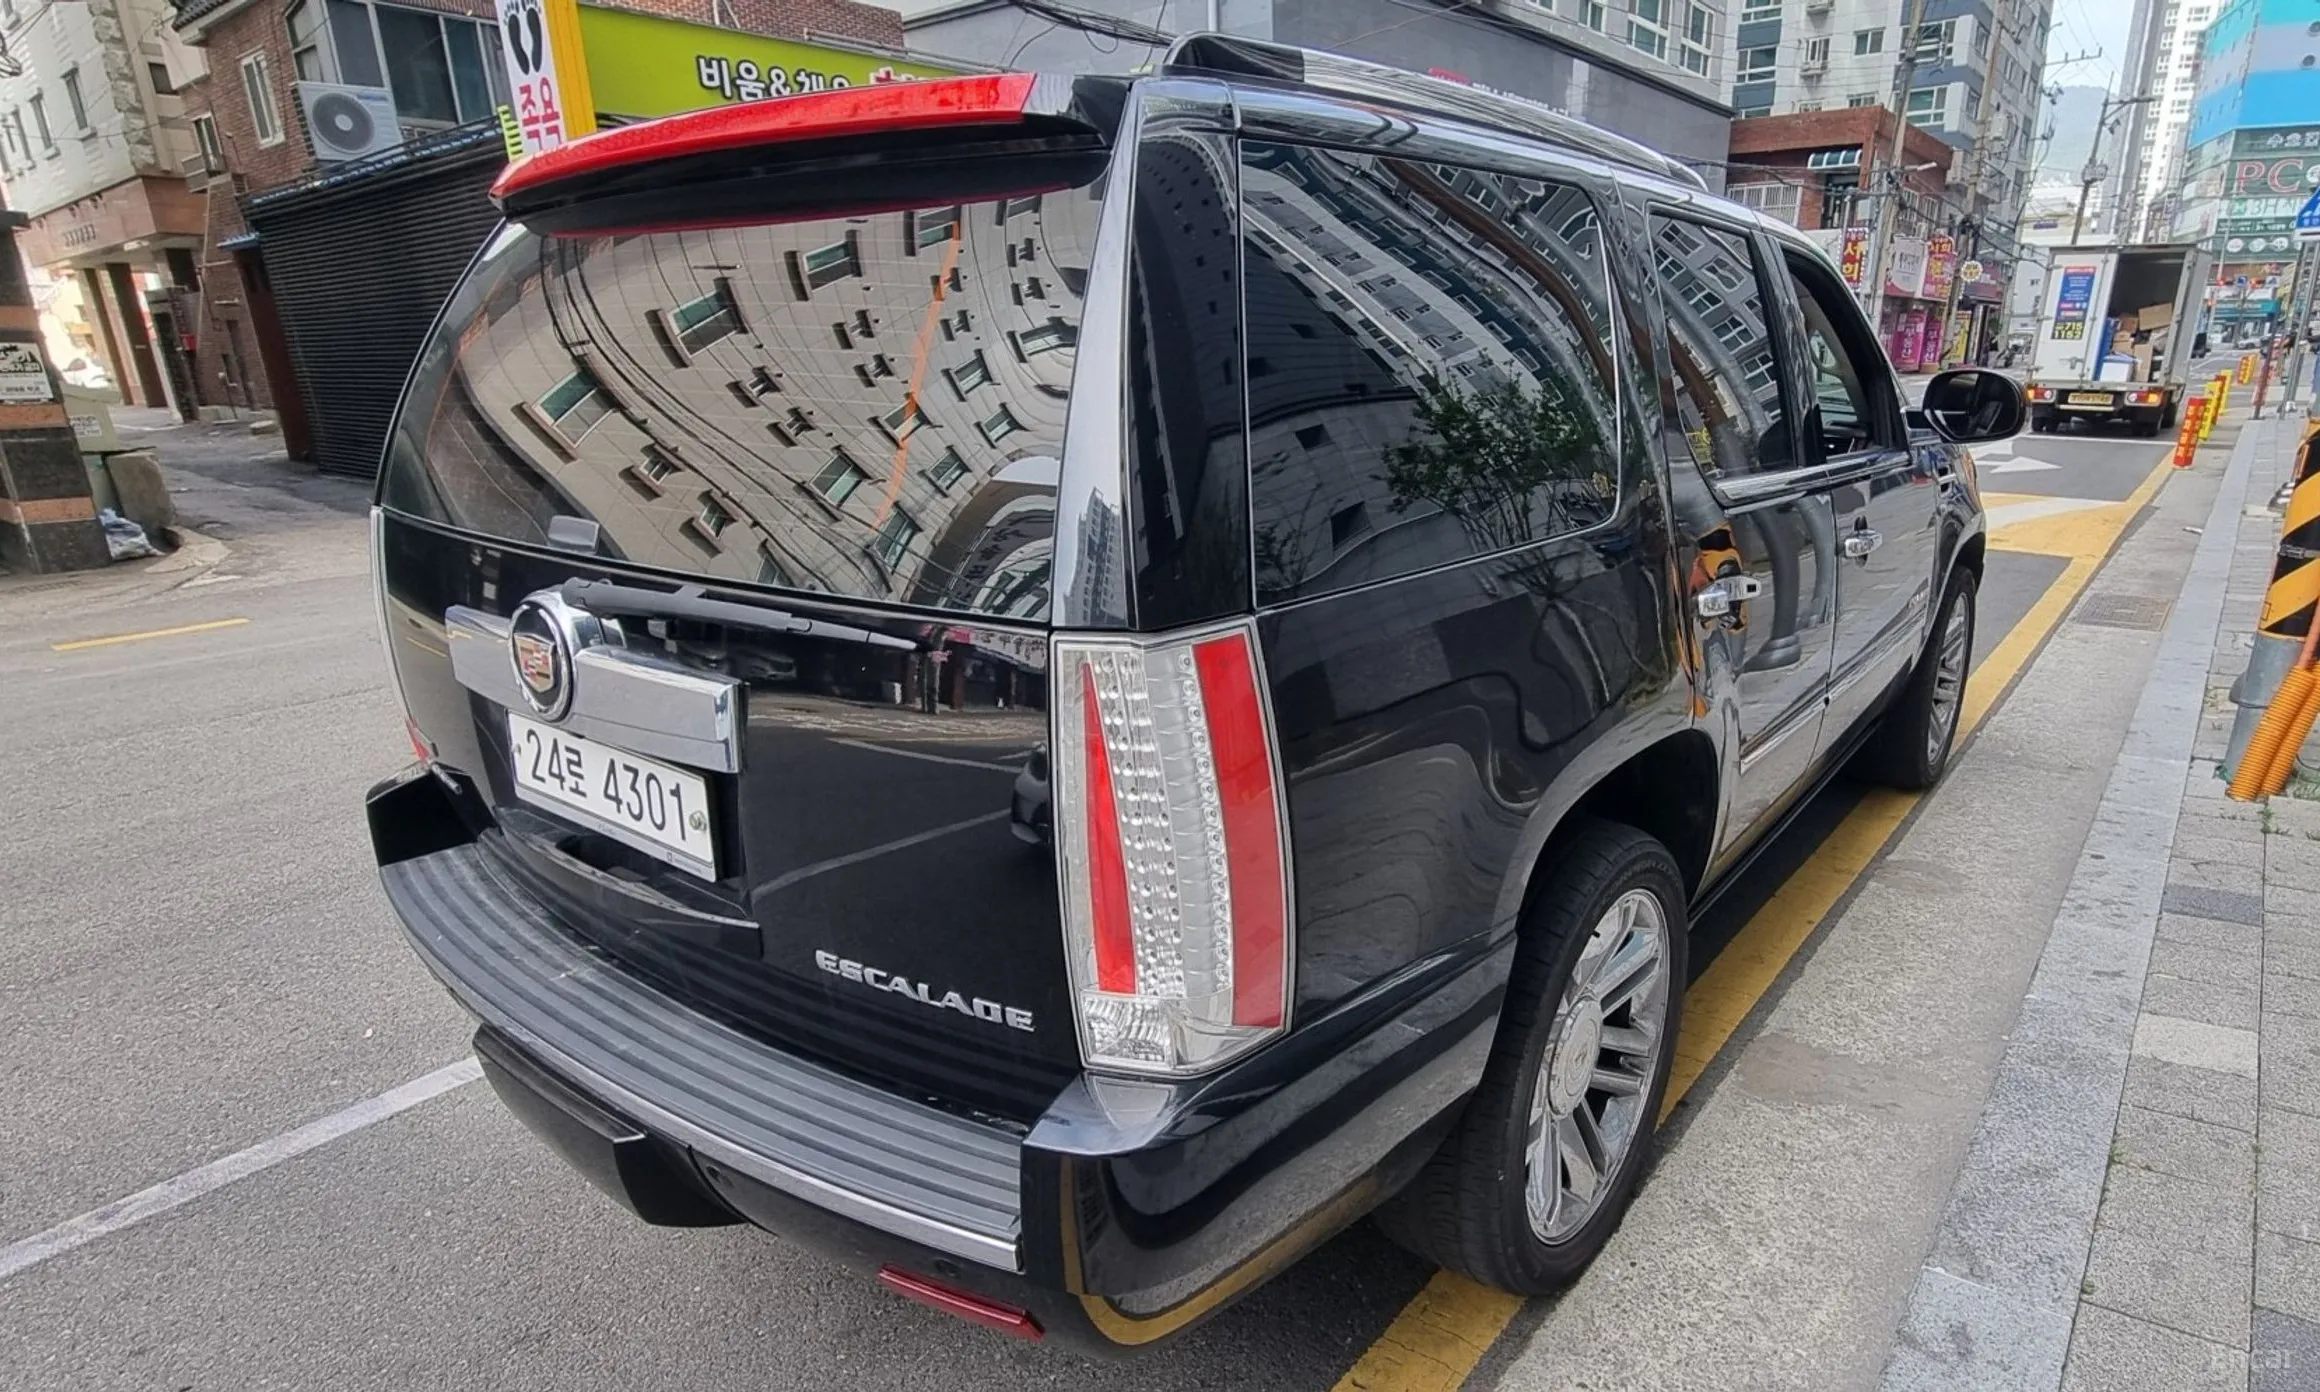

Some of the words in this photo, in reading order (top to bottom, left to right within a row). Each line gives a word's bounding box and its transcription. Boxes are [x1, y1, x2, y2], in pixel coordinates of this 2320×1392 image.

[527, 728, 587, 798] 24로
[603, 758, 686, 841] 4301
[815, 949, 1035, 1033] ESCALADE
